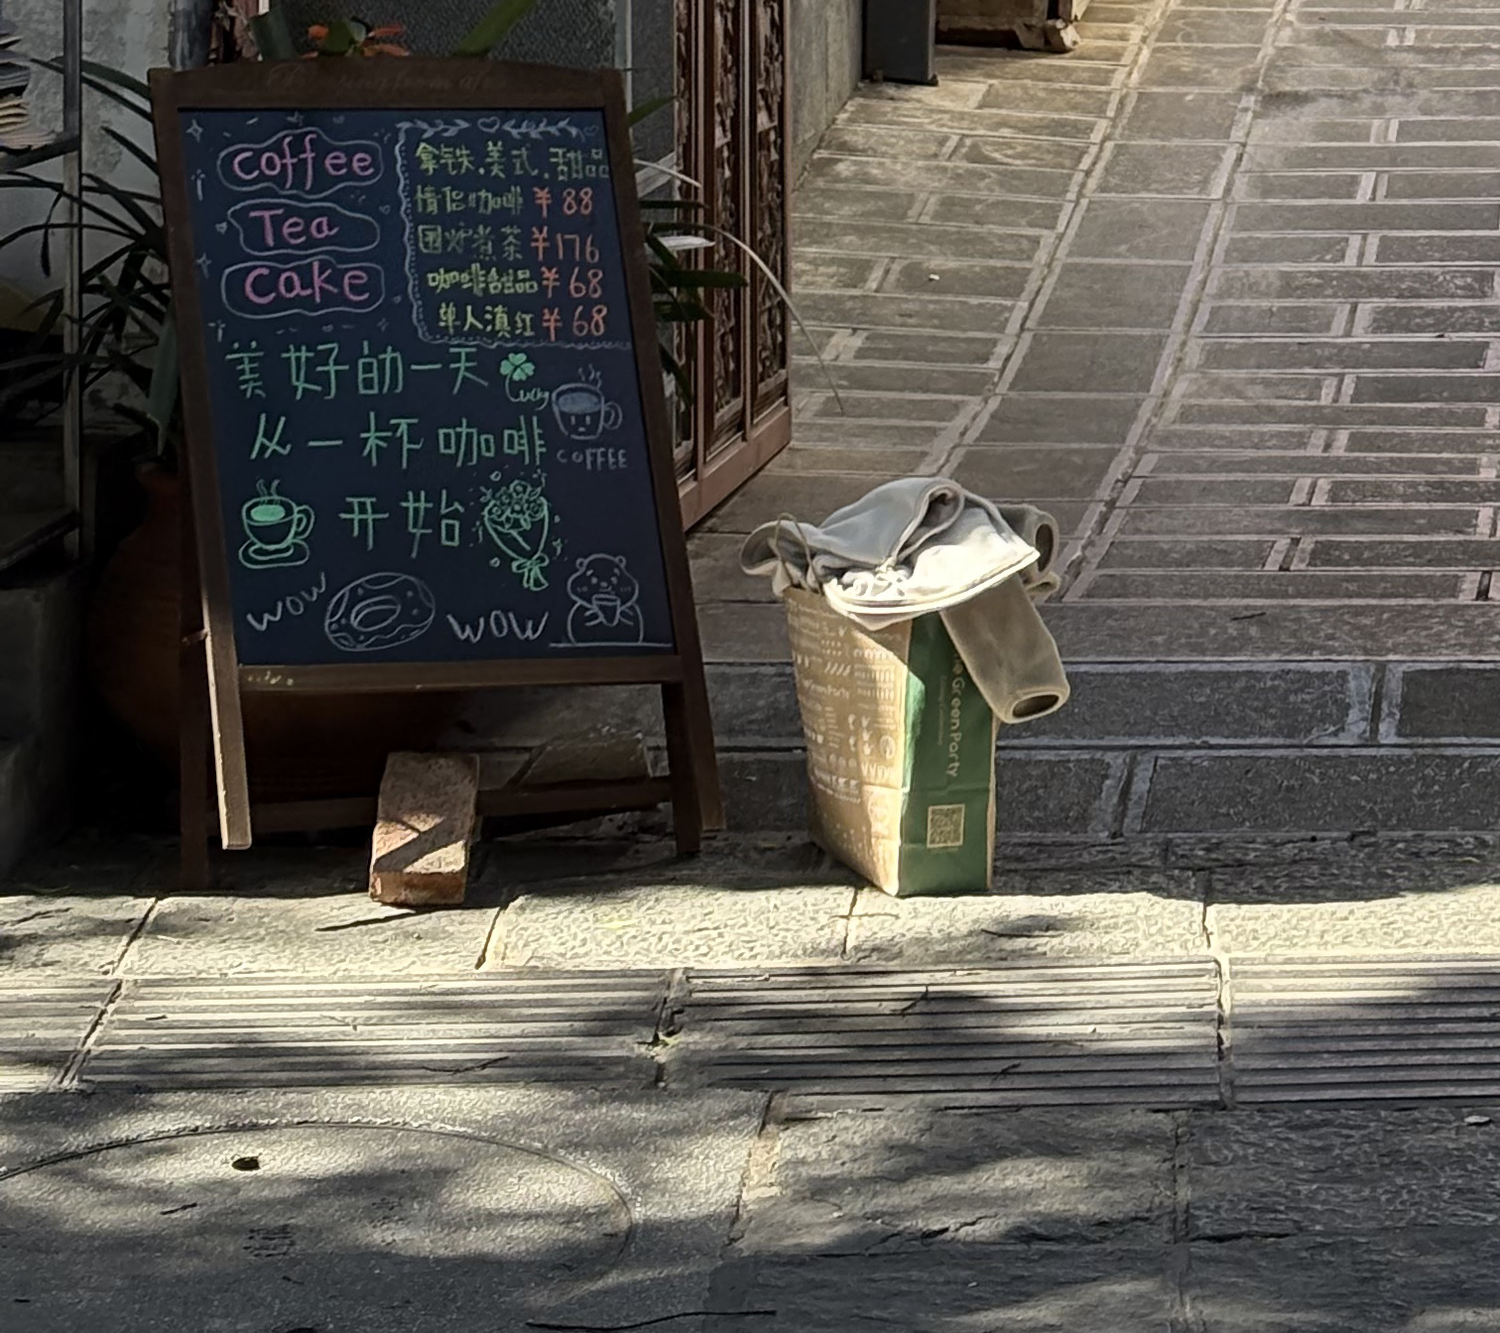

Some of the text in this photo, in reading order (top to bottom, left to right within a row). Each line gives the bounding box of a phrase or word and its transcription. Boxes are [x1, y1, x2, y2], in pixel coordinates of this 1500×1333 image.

[249, 207, 341, 248] Tea
[225, 339, 489, 401] 美好的一天
[249, 411, 548, 471] 从一杯咖啡
[339, 489, 466, 558] 开始
